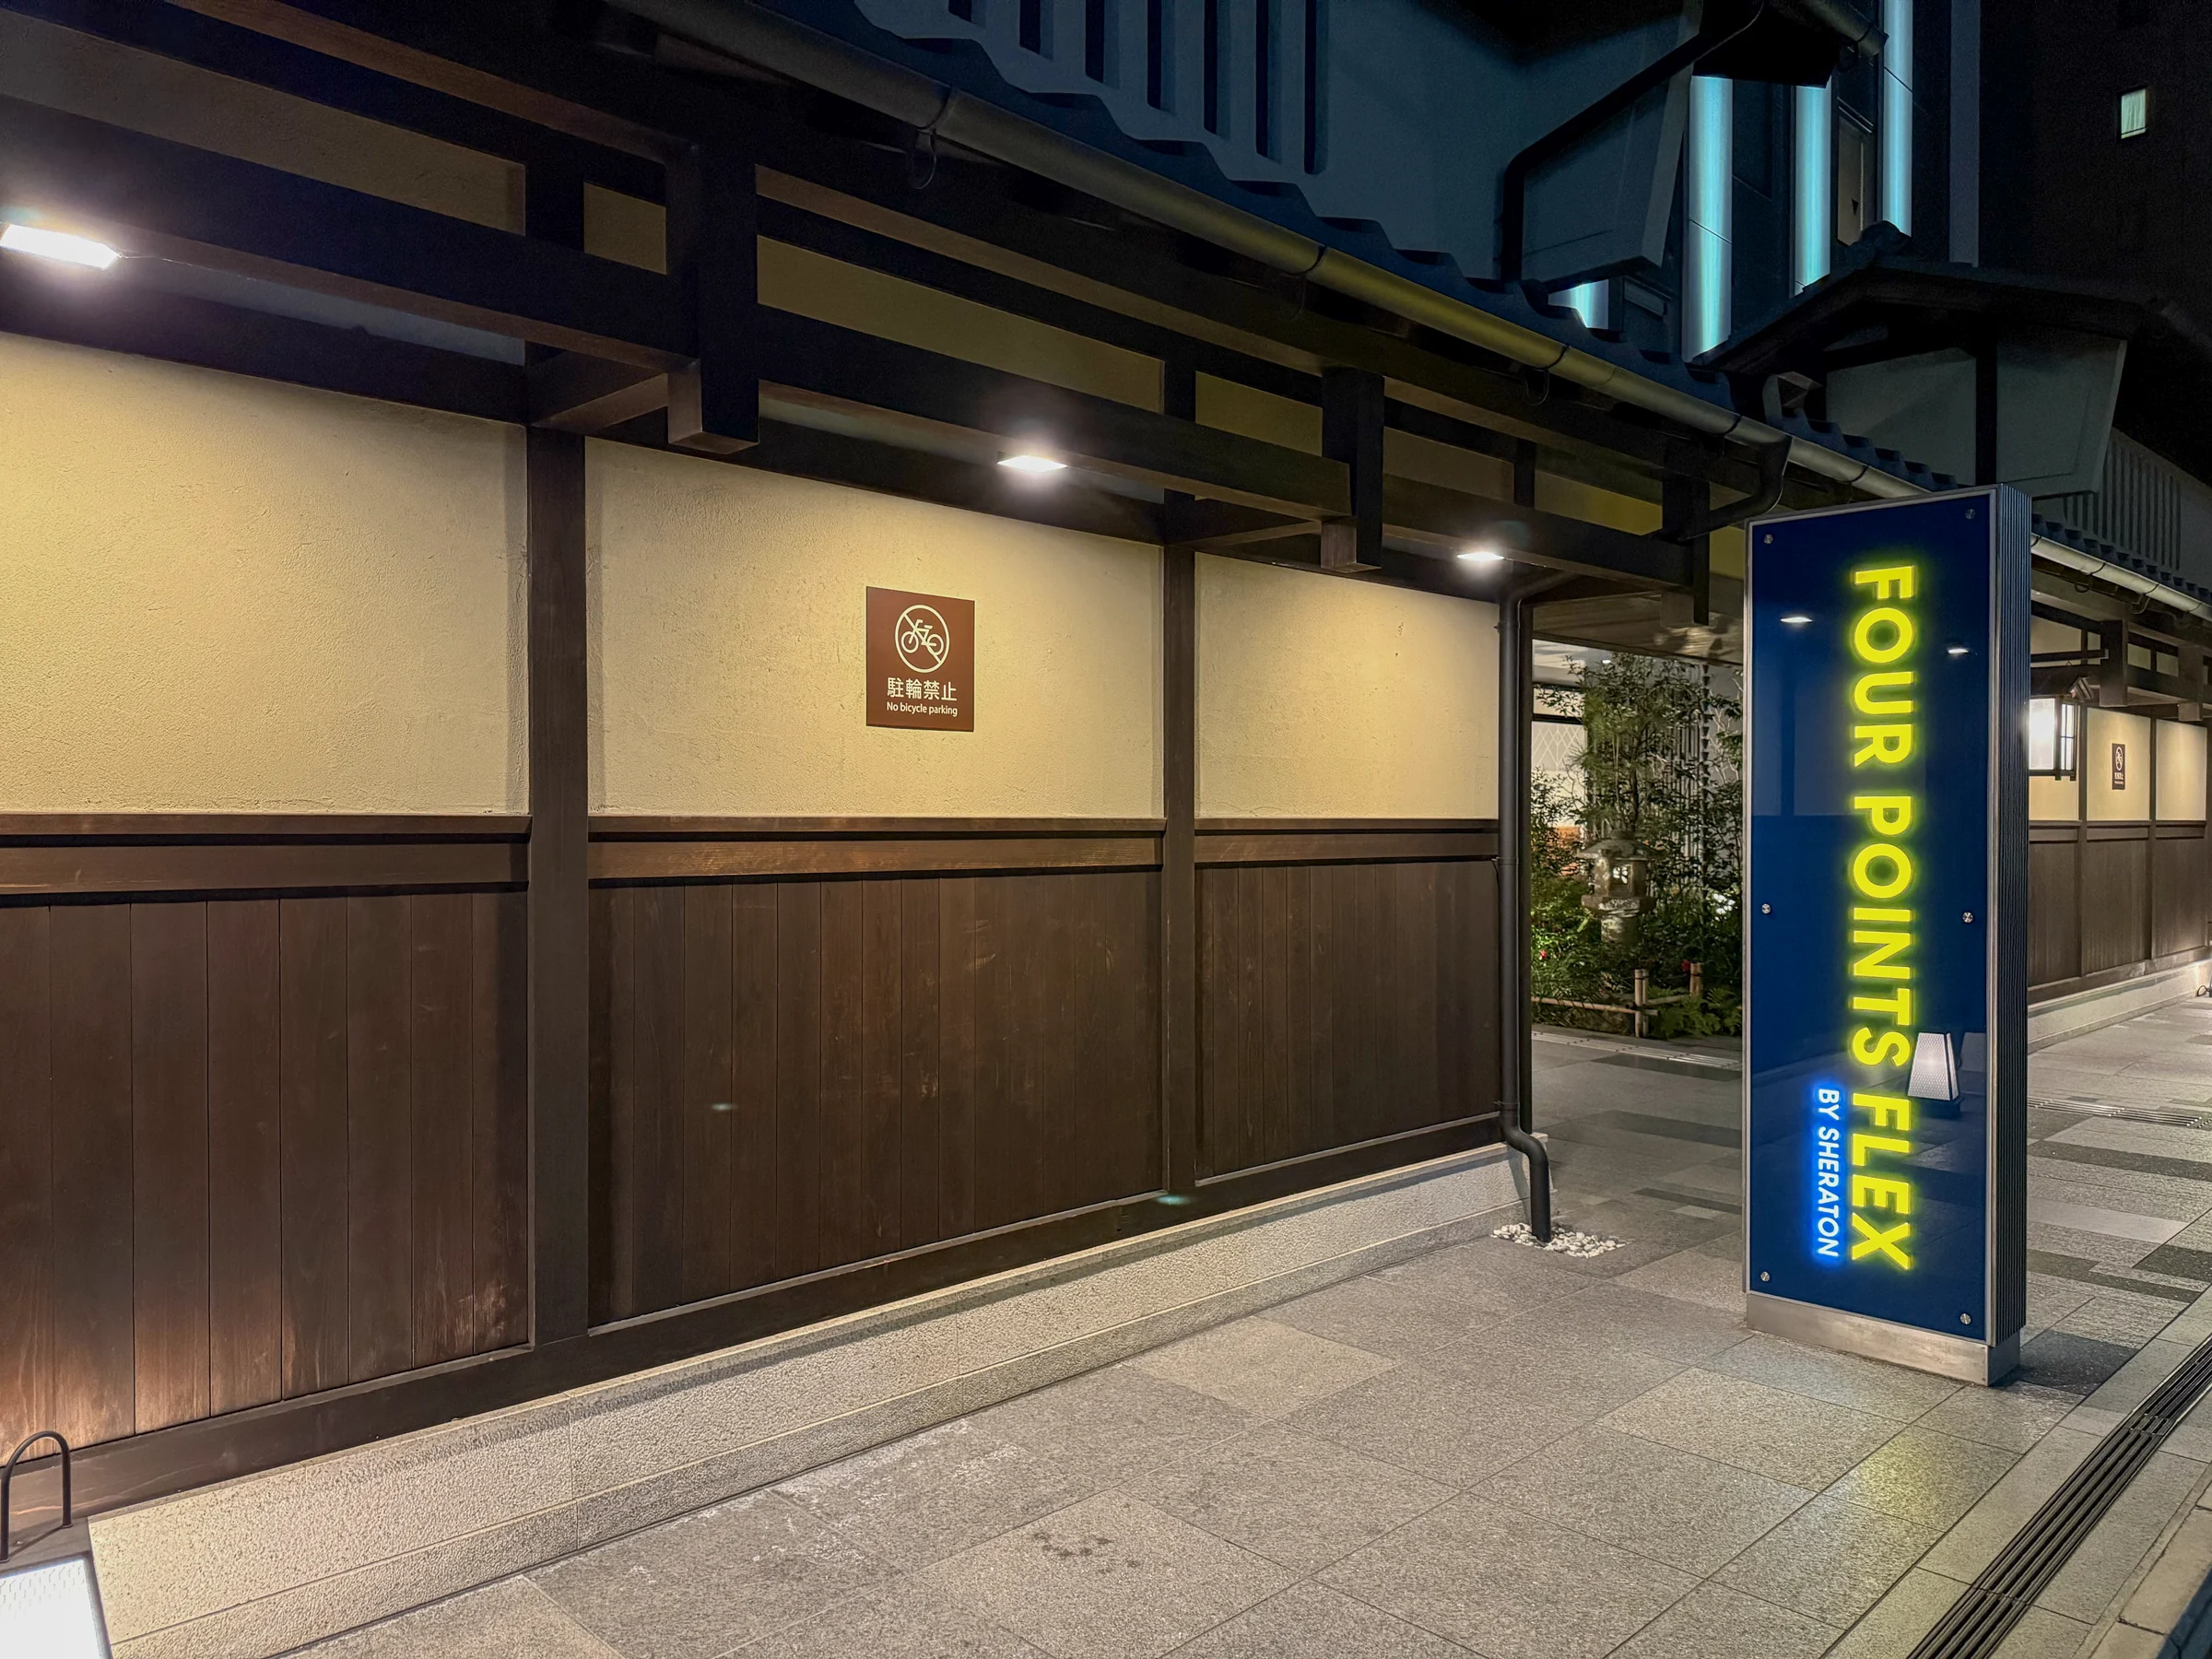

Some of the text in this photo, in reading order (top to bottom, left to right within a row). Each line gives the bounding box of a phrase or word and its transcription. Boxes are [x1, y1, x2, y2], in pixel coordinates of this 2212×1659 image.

[887, 677, 957, 701] 駐輪禁止
[887, 701, 958, 717] No bicycle parking
[1852, 566, 1913, 1271] FOUR POINTS FLEX
[1818, 1088, 1839, 1257] BY SHERATON
